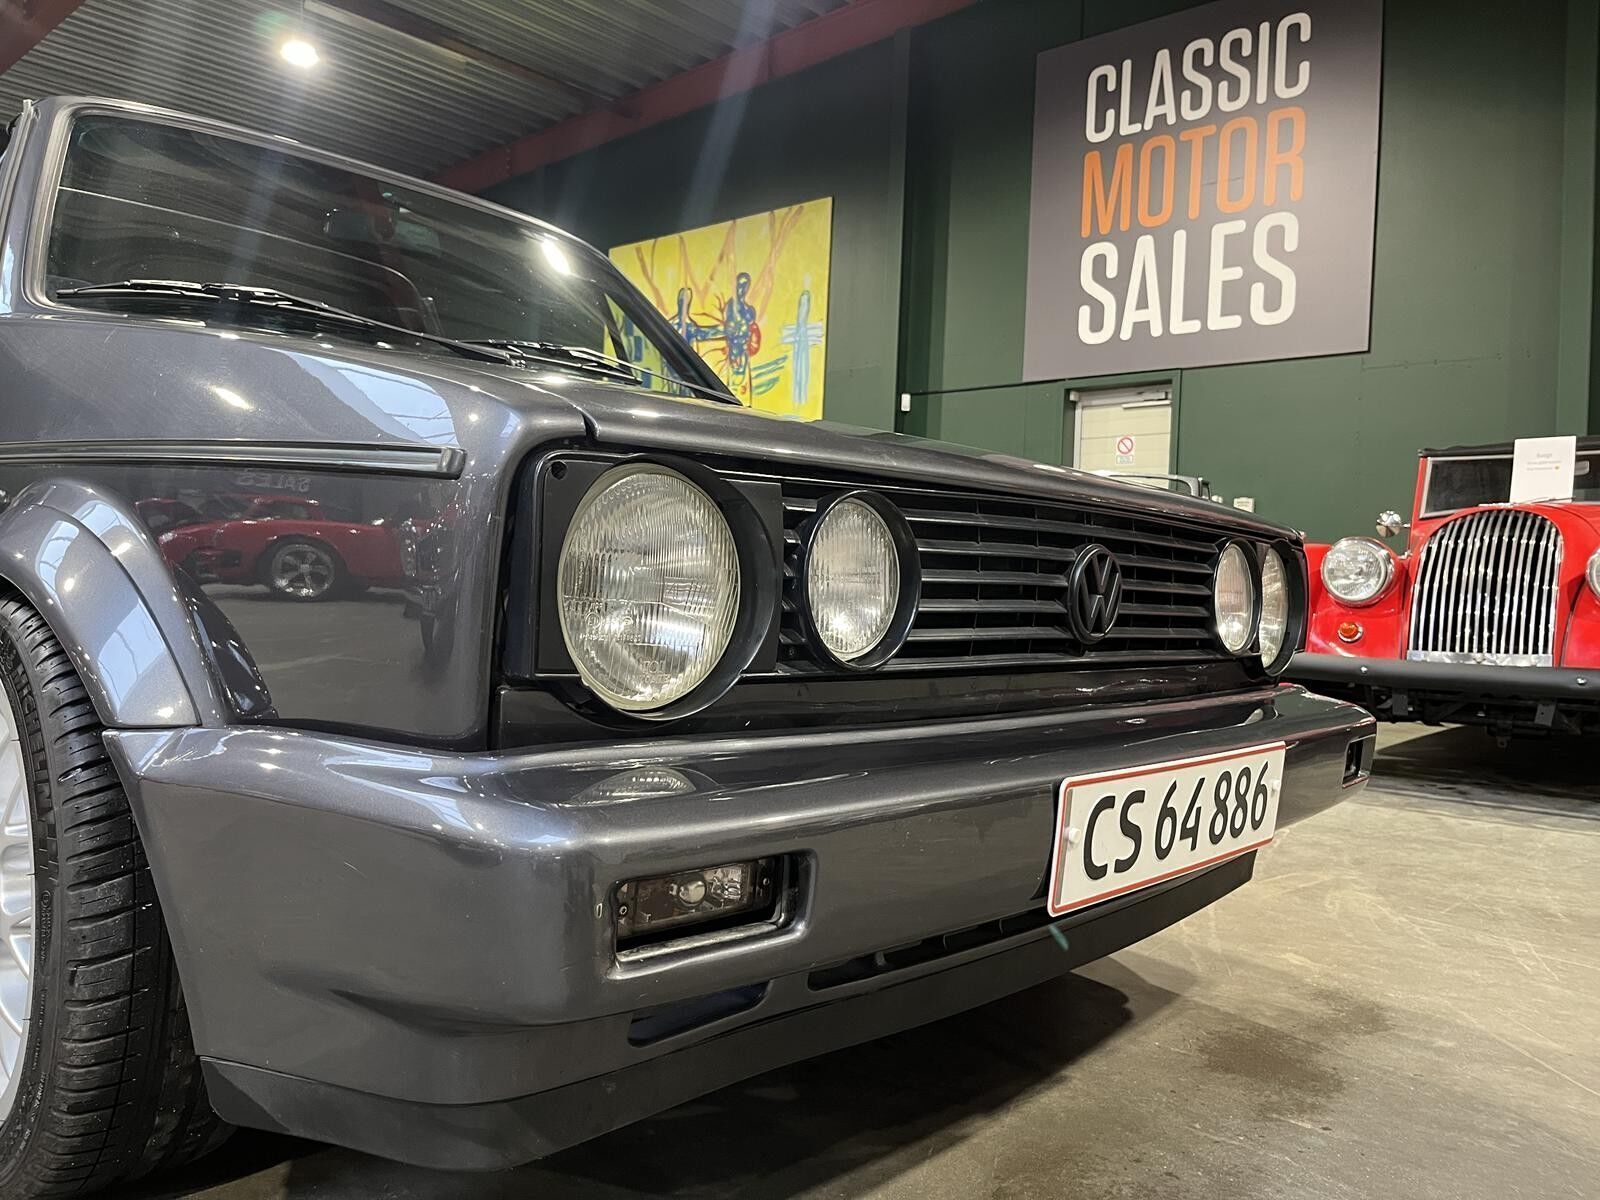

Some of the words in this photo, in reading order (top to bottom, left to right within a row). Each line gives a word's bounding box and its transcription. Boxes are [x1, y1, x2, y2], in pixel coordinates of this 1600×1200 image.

[1085, 12, 1311, 143] CLASSIC
[1081, 106, 1307, 238] MOTOR
[1078, 211, 1299, 345] SALES
[1083, 789, 1146, 880] CS
